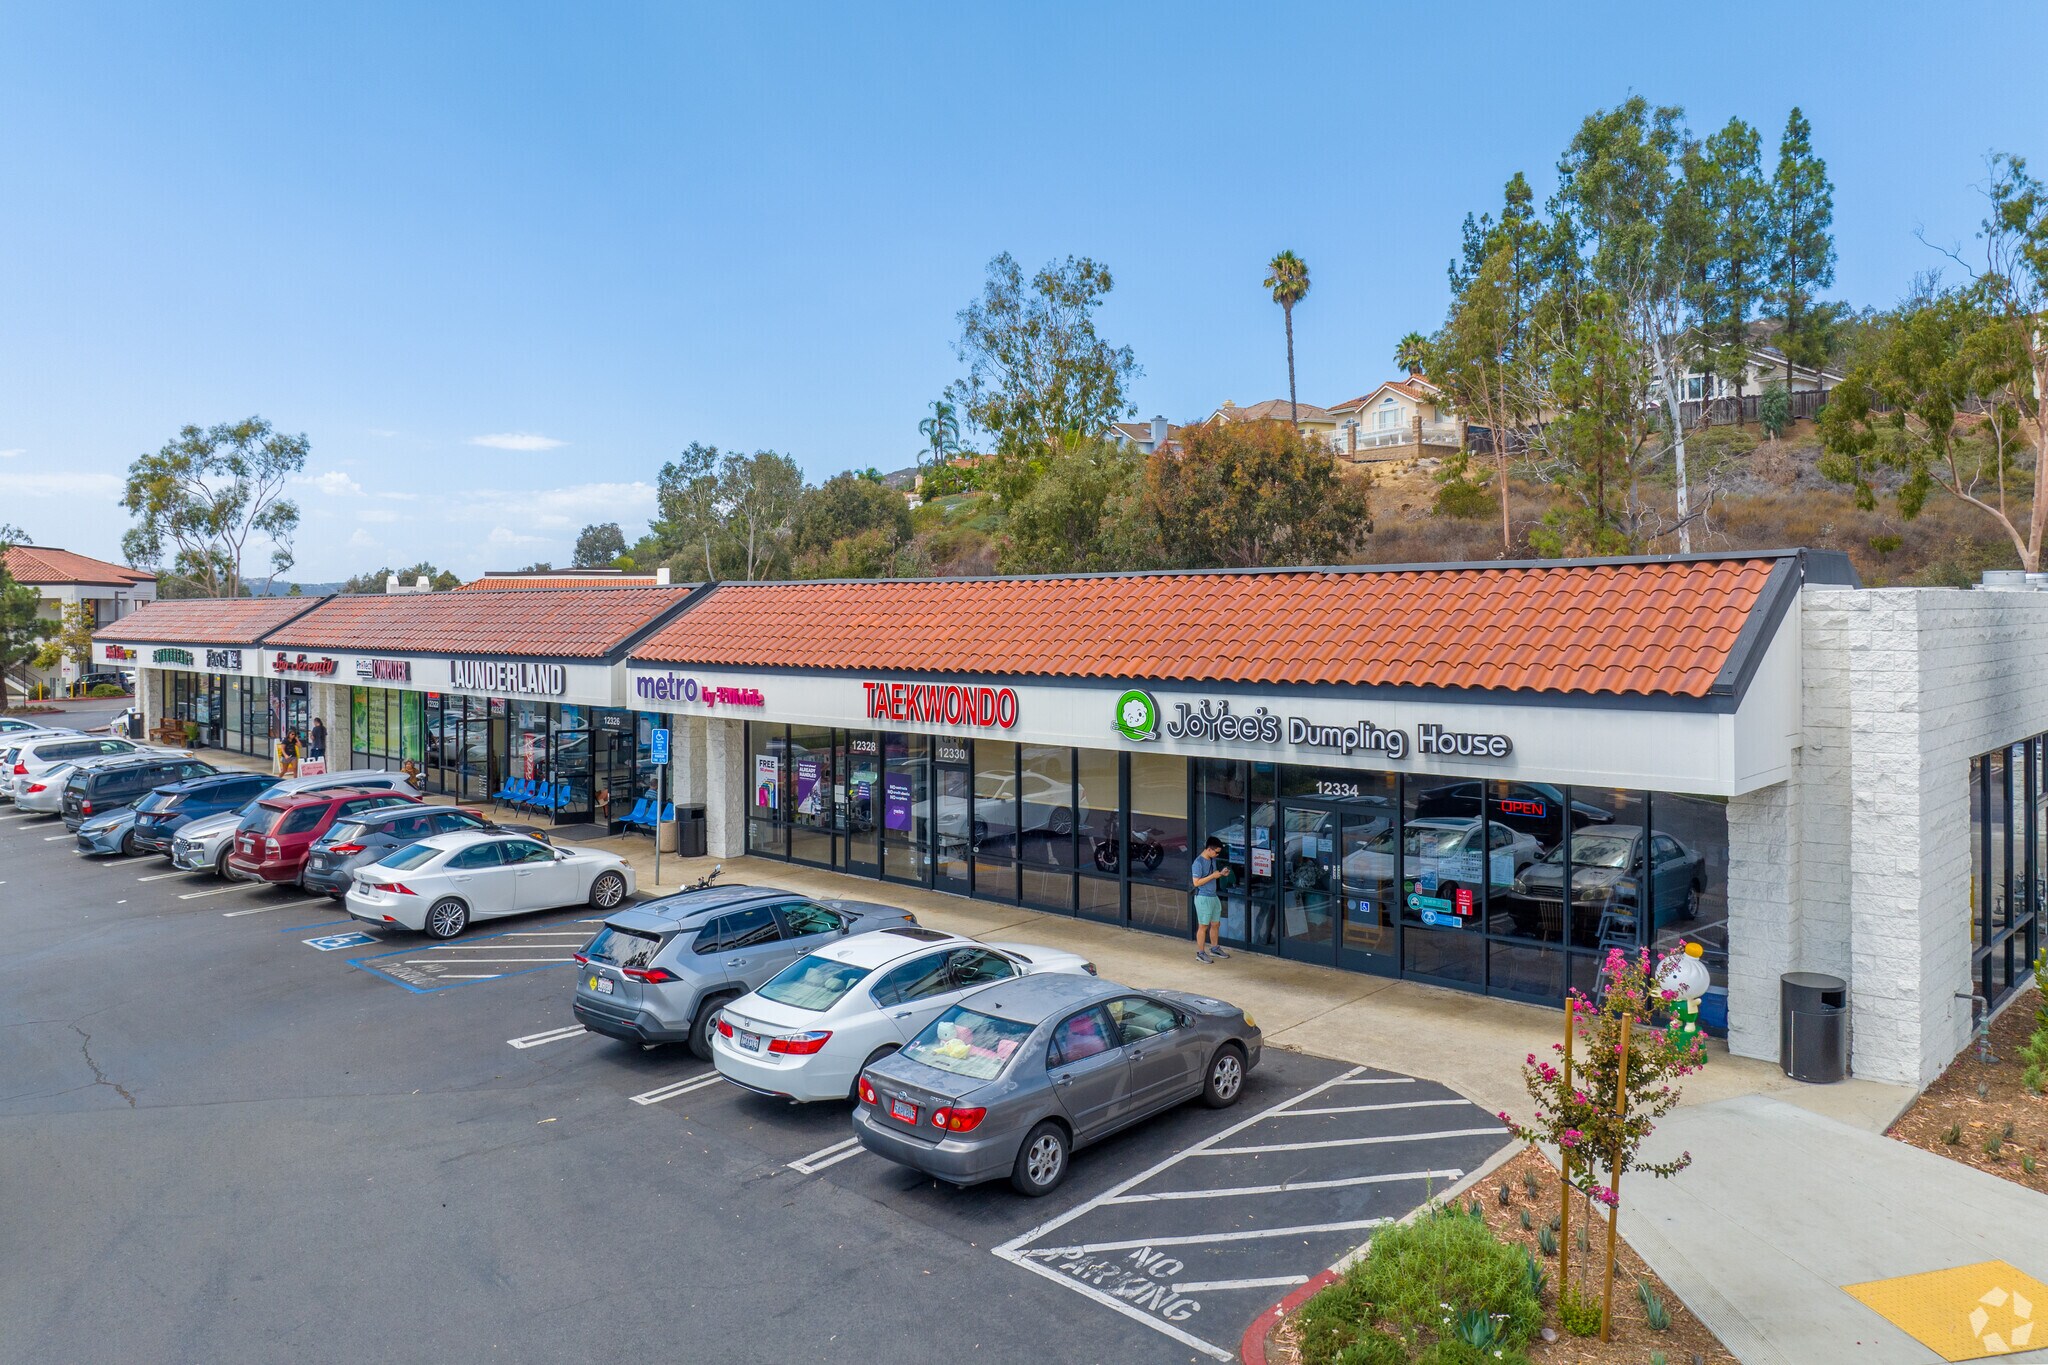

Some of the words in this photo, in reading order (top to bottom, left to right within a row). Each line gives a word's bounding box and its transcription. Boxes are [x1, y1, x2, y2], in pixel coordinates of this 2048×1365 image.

[272, 651, 289, 673] Spa
[291, 654, 336, 676] Serenity
[373, 659, 407, 680] COMPUTER
[450, 660, 565, 695] LAUNDERLAND
[637, 672, 698, 702] metro
[863, 682, 1018, 728] TAEKWONDO
[604, 716, 620, 725] 12326
[852, 740, 876, 752] 12328
[1289, 716, 1409, 760] Dumpling
[1417, 723, 1513, 758] House
[759, 759, 775, 768] FREE
[939, 748, 965, 760] 12330
[1316, 781, 1359, 797] 12334
[1501, 800, 1543, 815] OPEN
[1123, 1246, 1184, 1277] NO
[1043, 1249, 1201, 1321] PARKING
